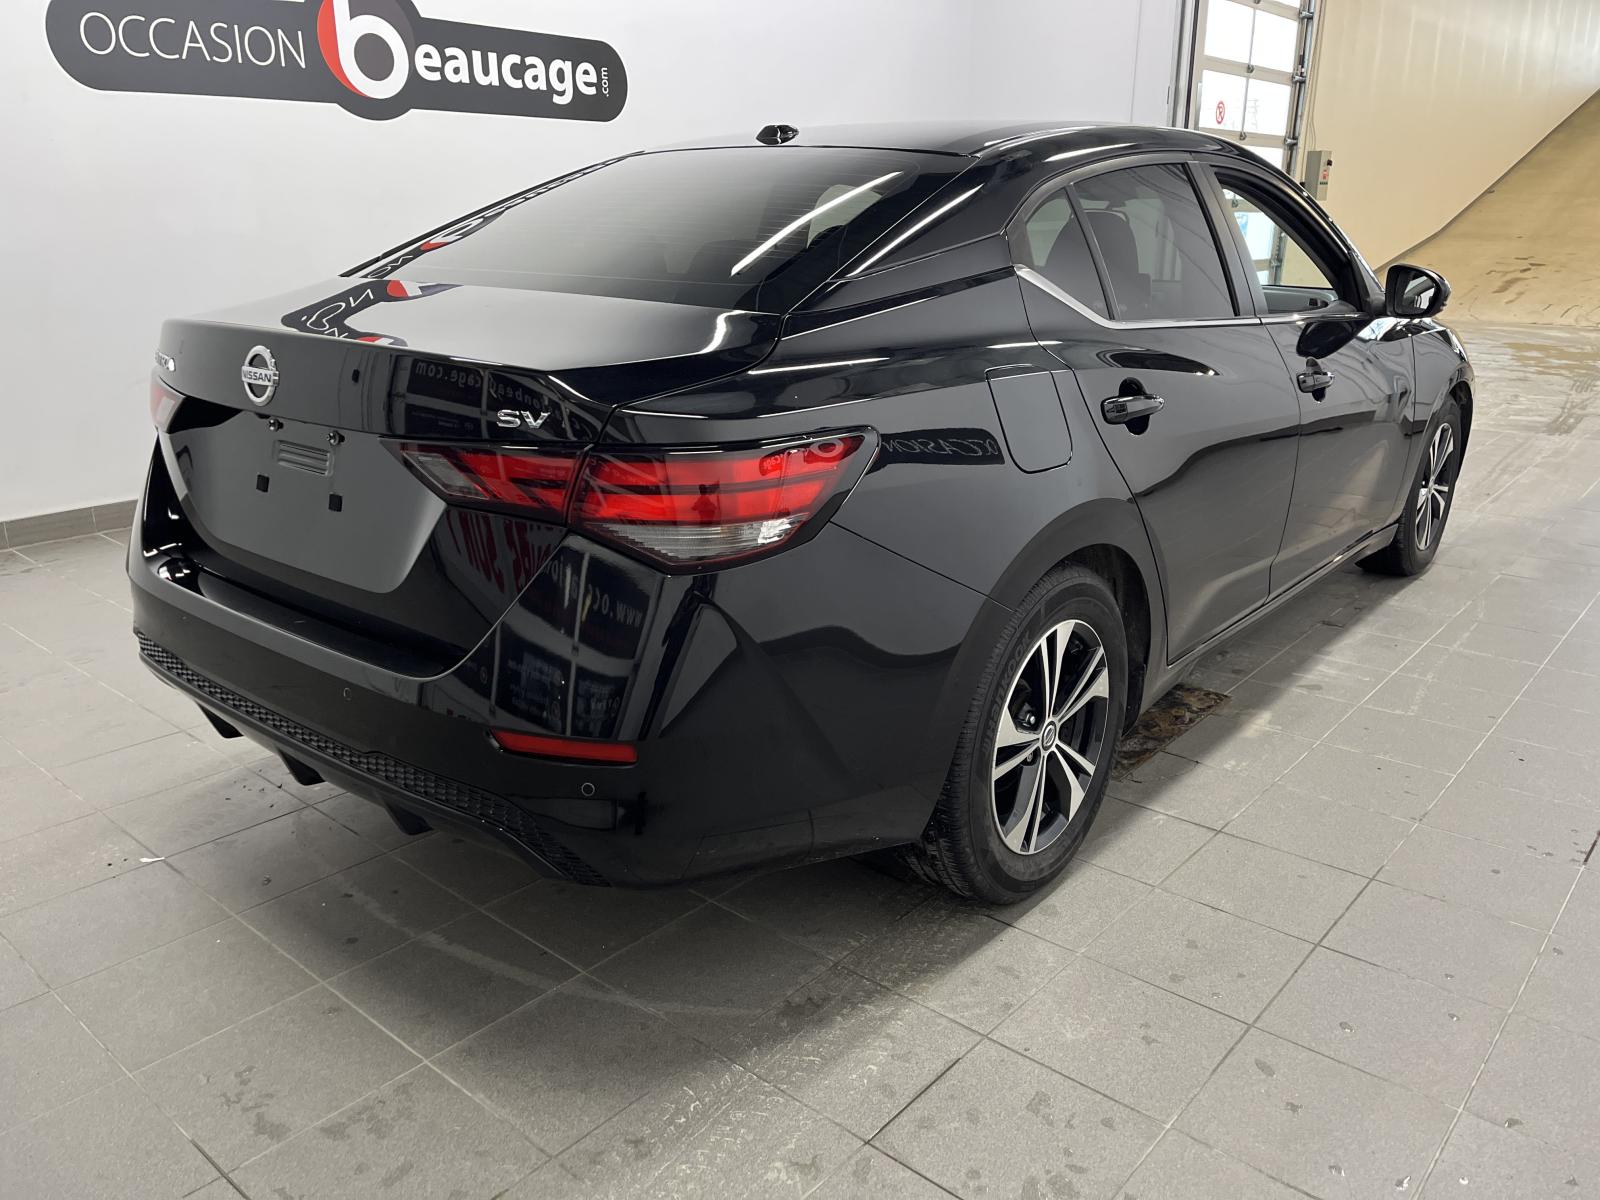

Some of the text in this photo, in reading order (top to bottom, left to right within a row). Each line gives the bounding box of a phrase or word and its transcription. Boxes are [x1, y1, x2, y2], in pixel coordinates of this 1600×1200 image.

[80, 12, 306, 68] OCCASION
[242, 369, 272, 383] NISSAN
[497, 409, 551, 429] SV
